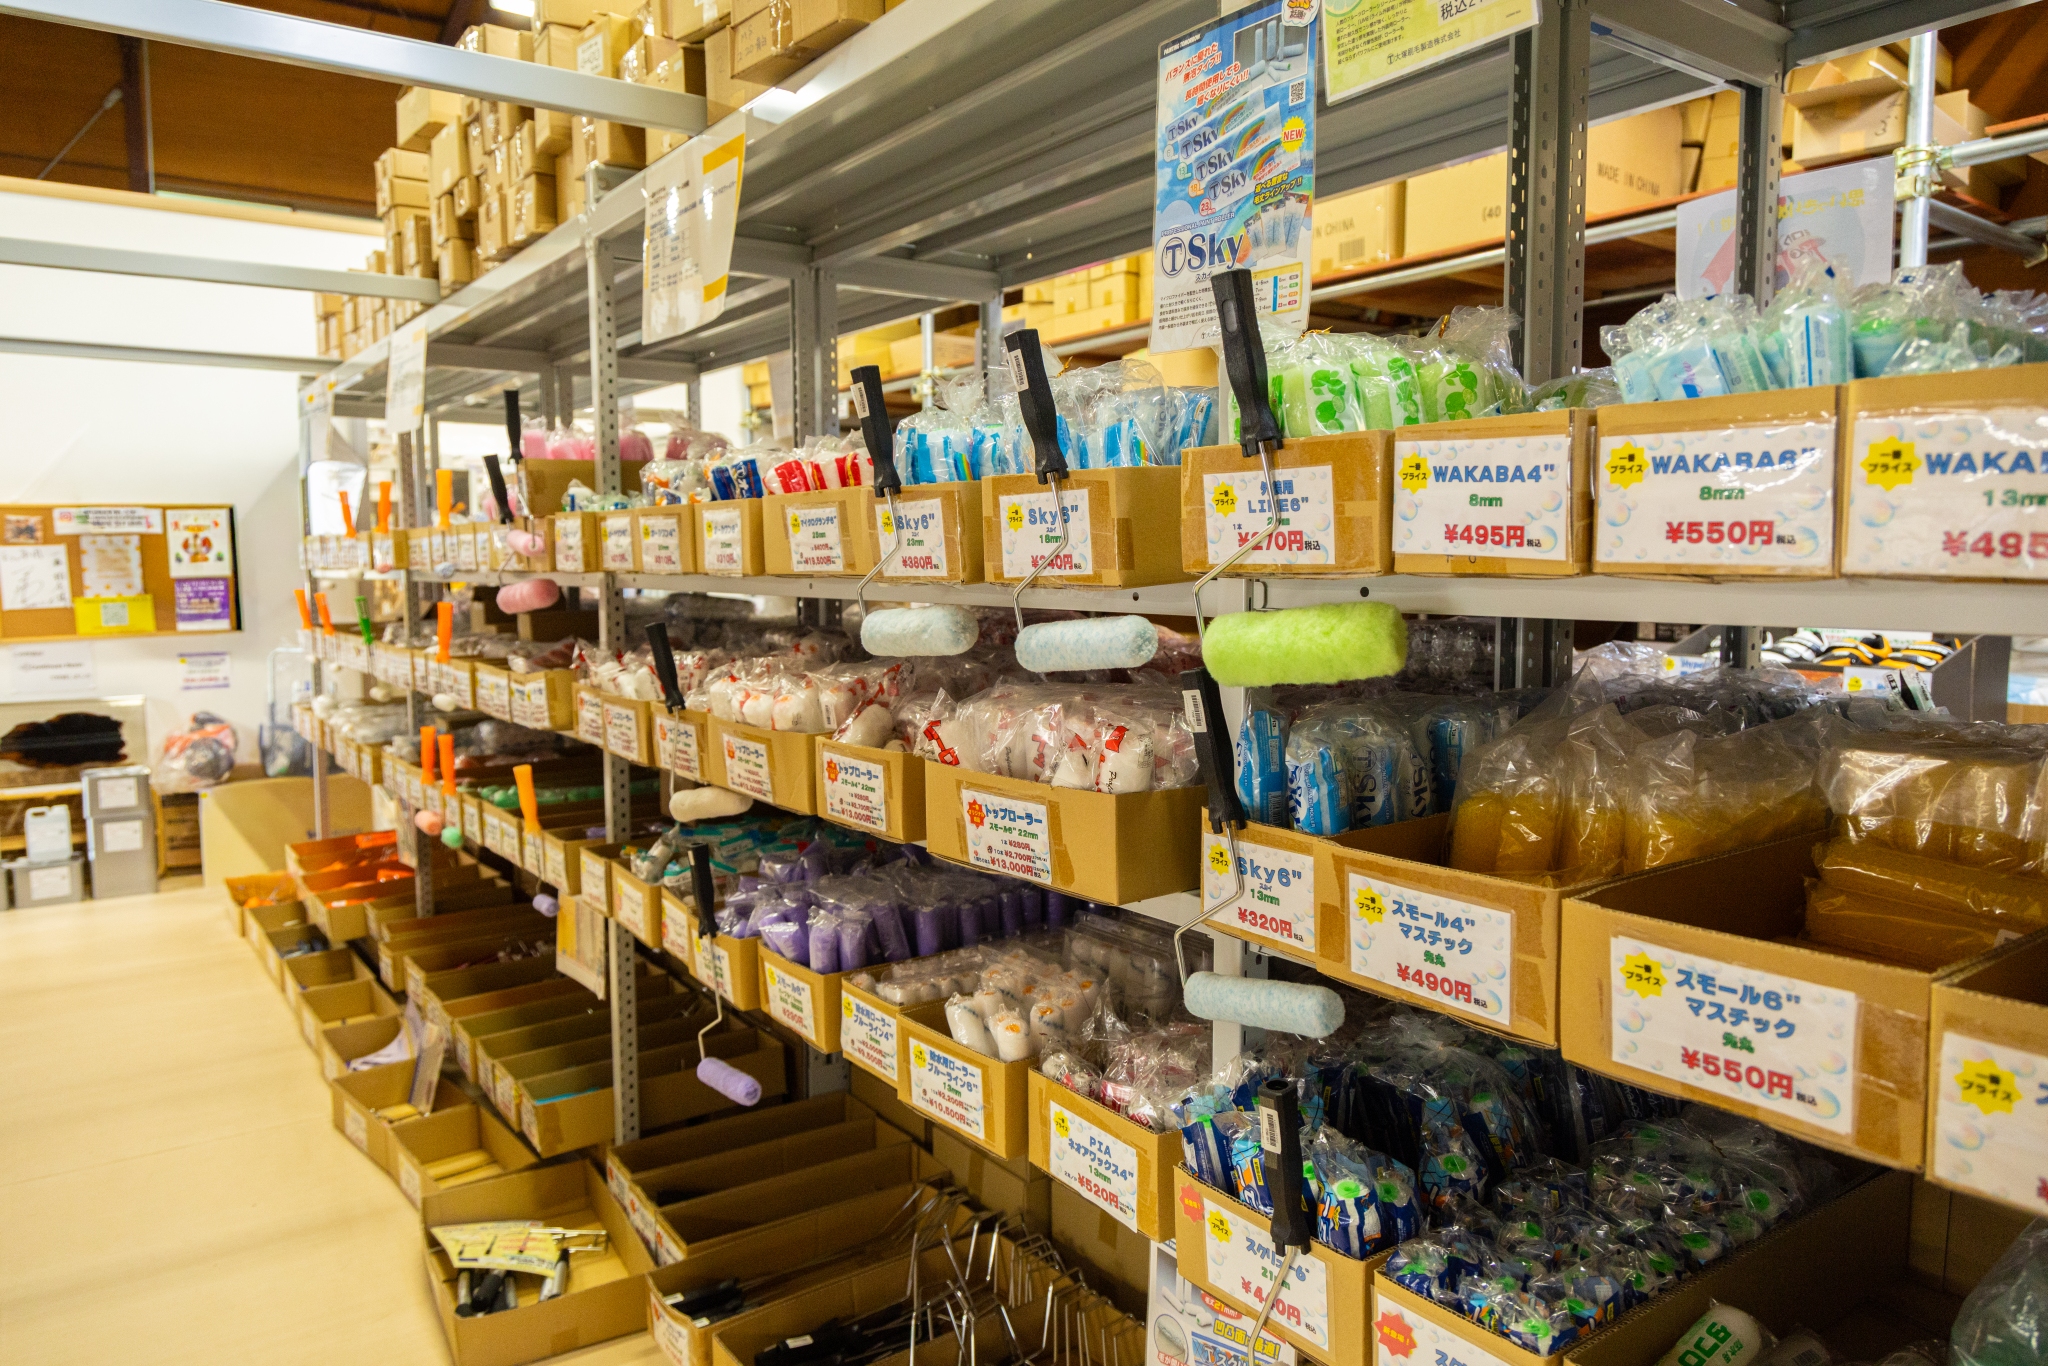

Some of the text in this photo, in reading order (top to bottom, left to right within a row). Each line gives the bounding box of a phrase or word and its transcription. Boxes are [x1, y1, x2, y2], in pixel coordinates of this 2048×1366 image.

[1394, 28, 1461, 63] 大塚刷毛製造株式会社
[1185, 63, 1241, 101] 長時間使用しても
[1177, 116, 1198, 136] Sky
[1283, 129, 1304, 141] NEW
[1194, 127, 1220, 152] Sky
[1208, 150, 1235, 174] Sky
[1221, 170, 1248, 194] Sky
[1597, 162, 1661, 196] MADE IN CHINA
[1161, 222, 1198, 237] PROFESSIONAL
[1214, 212, 1235, 224] ROLLER
[1325, 217, 1355, 236] CHINA
[1187, 233, 1244, 270] Sky
[1619, 454, 1635, 463] 一番
[1880, 450, 1902, 459] 一番
[1402, 473, 1427, 481] プライス
[1610, 464, 1643, 475] プライス
[1868, 463, 1913, 473] プライス
[1469, 494, 1503, 507] 8mm
[1699, 486, 1745, 500] 8mm
[1444, 524, 1542, 548] ¥495円 税込
[1666, 521, 1797, 545] ¥550円 税込
[907, 538, 924, 547] 23mm
[1305, 541, 1321, 551] 税込
[902, 556, 934, 569] ¥380円
[838, 762, 879, 781] トップローラー
[985, 804, 1042, 825] トップローラー
[1018, 829, 1039, 840] 22mm
[1009, 840, 1030, 851] ¥280円
[1004, 850, 1032, 862] ¥2,700円
[1211, 857, 1229, 867] プライス
[990, 857, 1033, 876] ¥13,000円
[1259, 883, 1272, 892] スカイ
[1250, 889, 1280, 906] 13mm
[1359, 902, 1383, 915] プライス
[1238, 907, 1304, 942] ¥320円 税込
[1399, 922, 1473, 955] マスチック
[1424, 950, 1446, 968] 先丸
[1635, 964, 1652, 973] 一番
[1397, 962, 1488, 1009] ¥490円 税込
[1626, 971, 1662, 987] プライス
[1686, 997, 1796, 1039] マスチック
[1723, 1032, 1755, 1054] 先丸
[1681, 1046, 1817, 1107] ¥550円 税込
[1976, 1073, 2001, 1086] 一番
[937, 1089, 965, 1109] ¥2,200円
[943, 1082, 962, 1098] 13mm
[1962, 1079, 2012, 1103] プライス
[929, 1097, 967, 1125] ¥10,500円
[1055, 1122, 1069, 1133] プライス
[1089, 1136, 1112, 1158] PIA
[1088, 1165, 1112, 1185] 13mm
[1077, 1173, 1119, 1210] ¥520円
[1211, 1222, 1229, 1237] プライス
[1215, 1218, 1224, 1226] 一番
[1304, 1321, 1317, 1335] 税込
